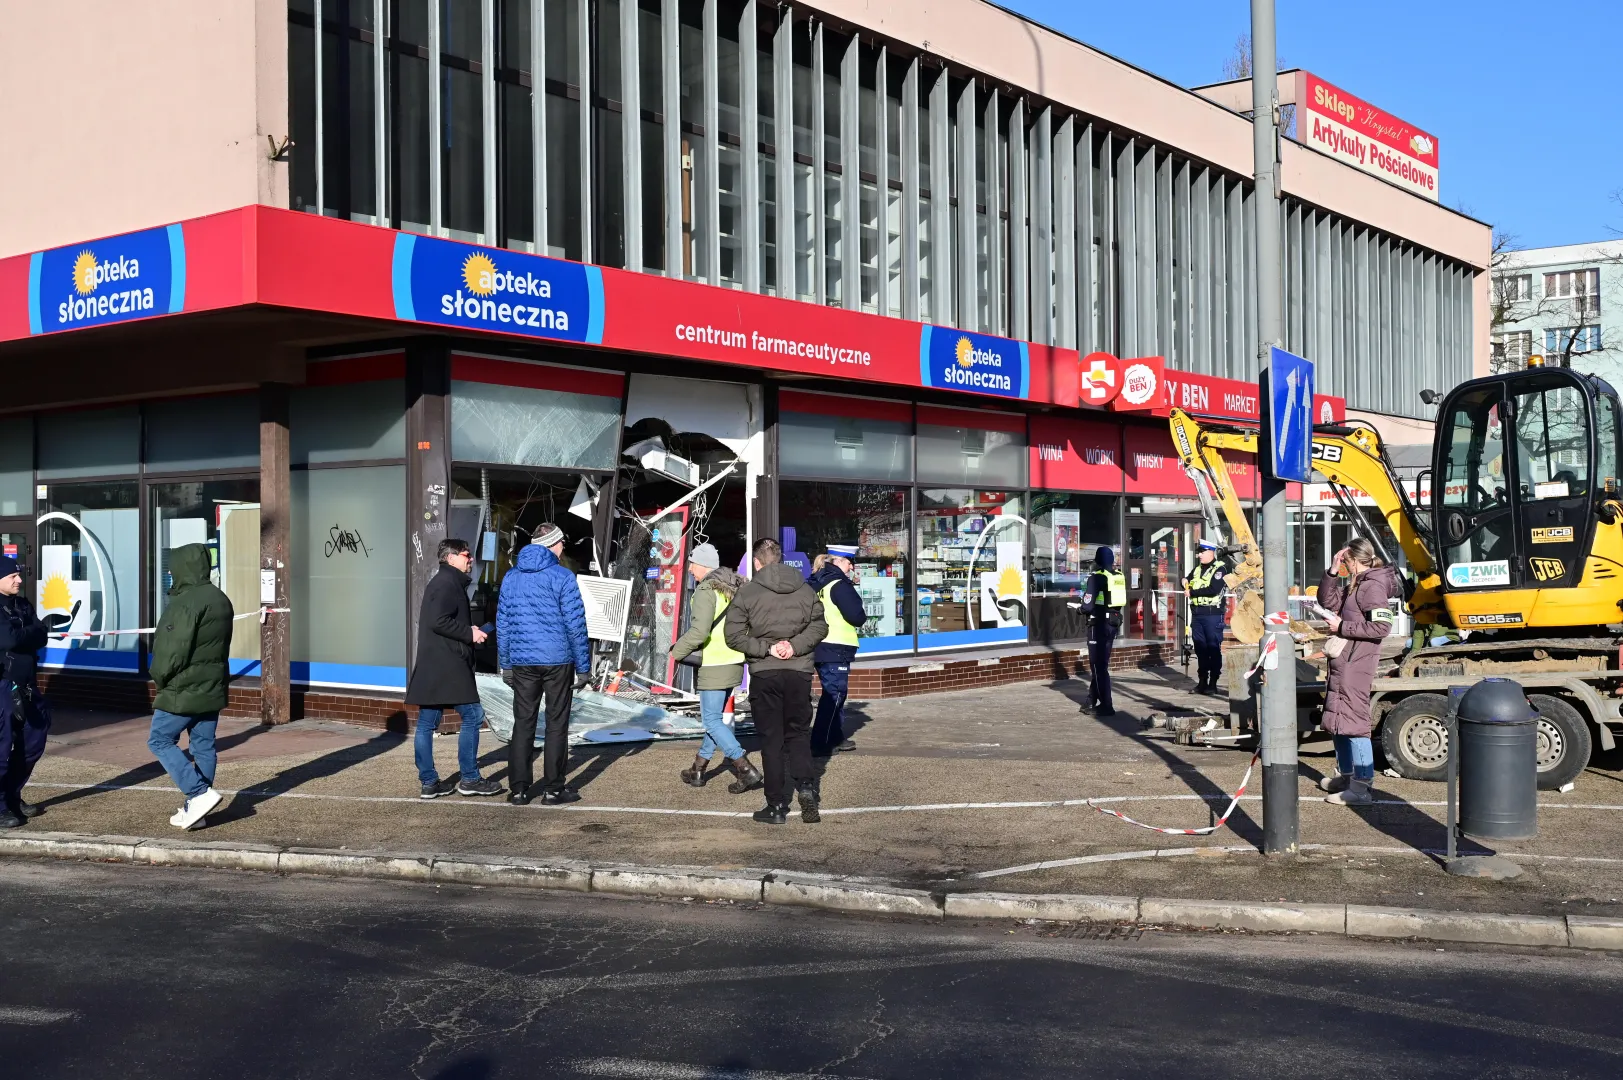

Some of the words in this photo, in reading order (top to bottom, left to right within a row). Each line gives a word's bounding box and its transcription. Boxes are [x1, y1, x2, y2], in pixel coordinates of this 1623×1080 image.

[1314, 85, 1355, 122] Sklep
[1313, 118, 1366, 164] Artykuły
[1370, 143, 1434, 190] Pościelowe
[84, 255, 139, 289] apteka
[479, 270, 551, 298] apteka
[58, 287, 154, 323] słoneczna
[441, 290, 569, 331] słoneczna
[675, 324, 747, 348] centrum
[752, 331, 871, 365] farmaceutyczne
[963, 348, 1002, 367] apteka
[944, 364, 1011, 390] słoneczna
[1129, 376, 1146, 384] DUŻY
[1130, 382, 1147, 392] BEN
[1182, 383, 1208, 411] BEN
[1224, 393, 1256, 414] MARKET
[1039, 444, 1063, 461] WINA
[1086, 445, 1114, 465] WÓDKI
[1133, 452, 1164, 469] WHISKY
[1547, 529, 1571, 537] JCB
[1471, 565, 1508, 577] ZWiK
[1535, 560, 1563, 581] JCB
